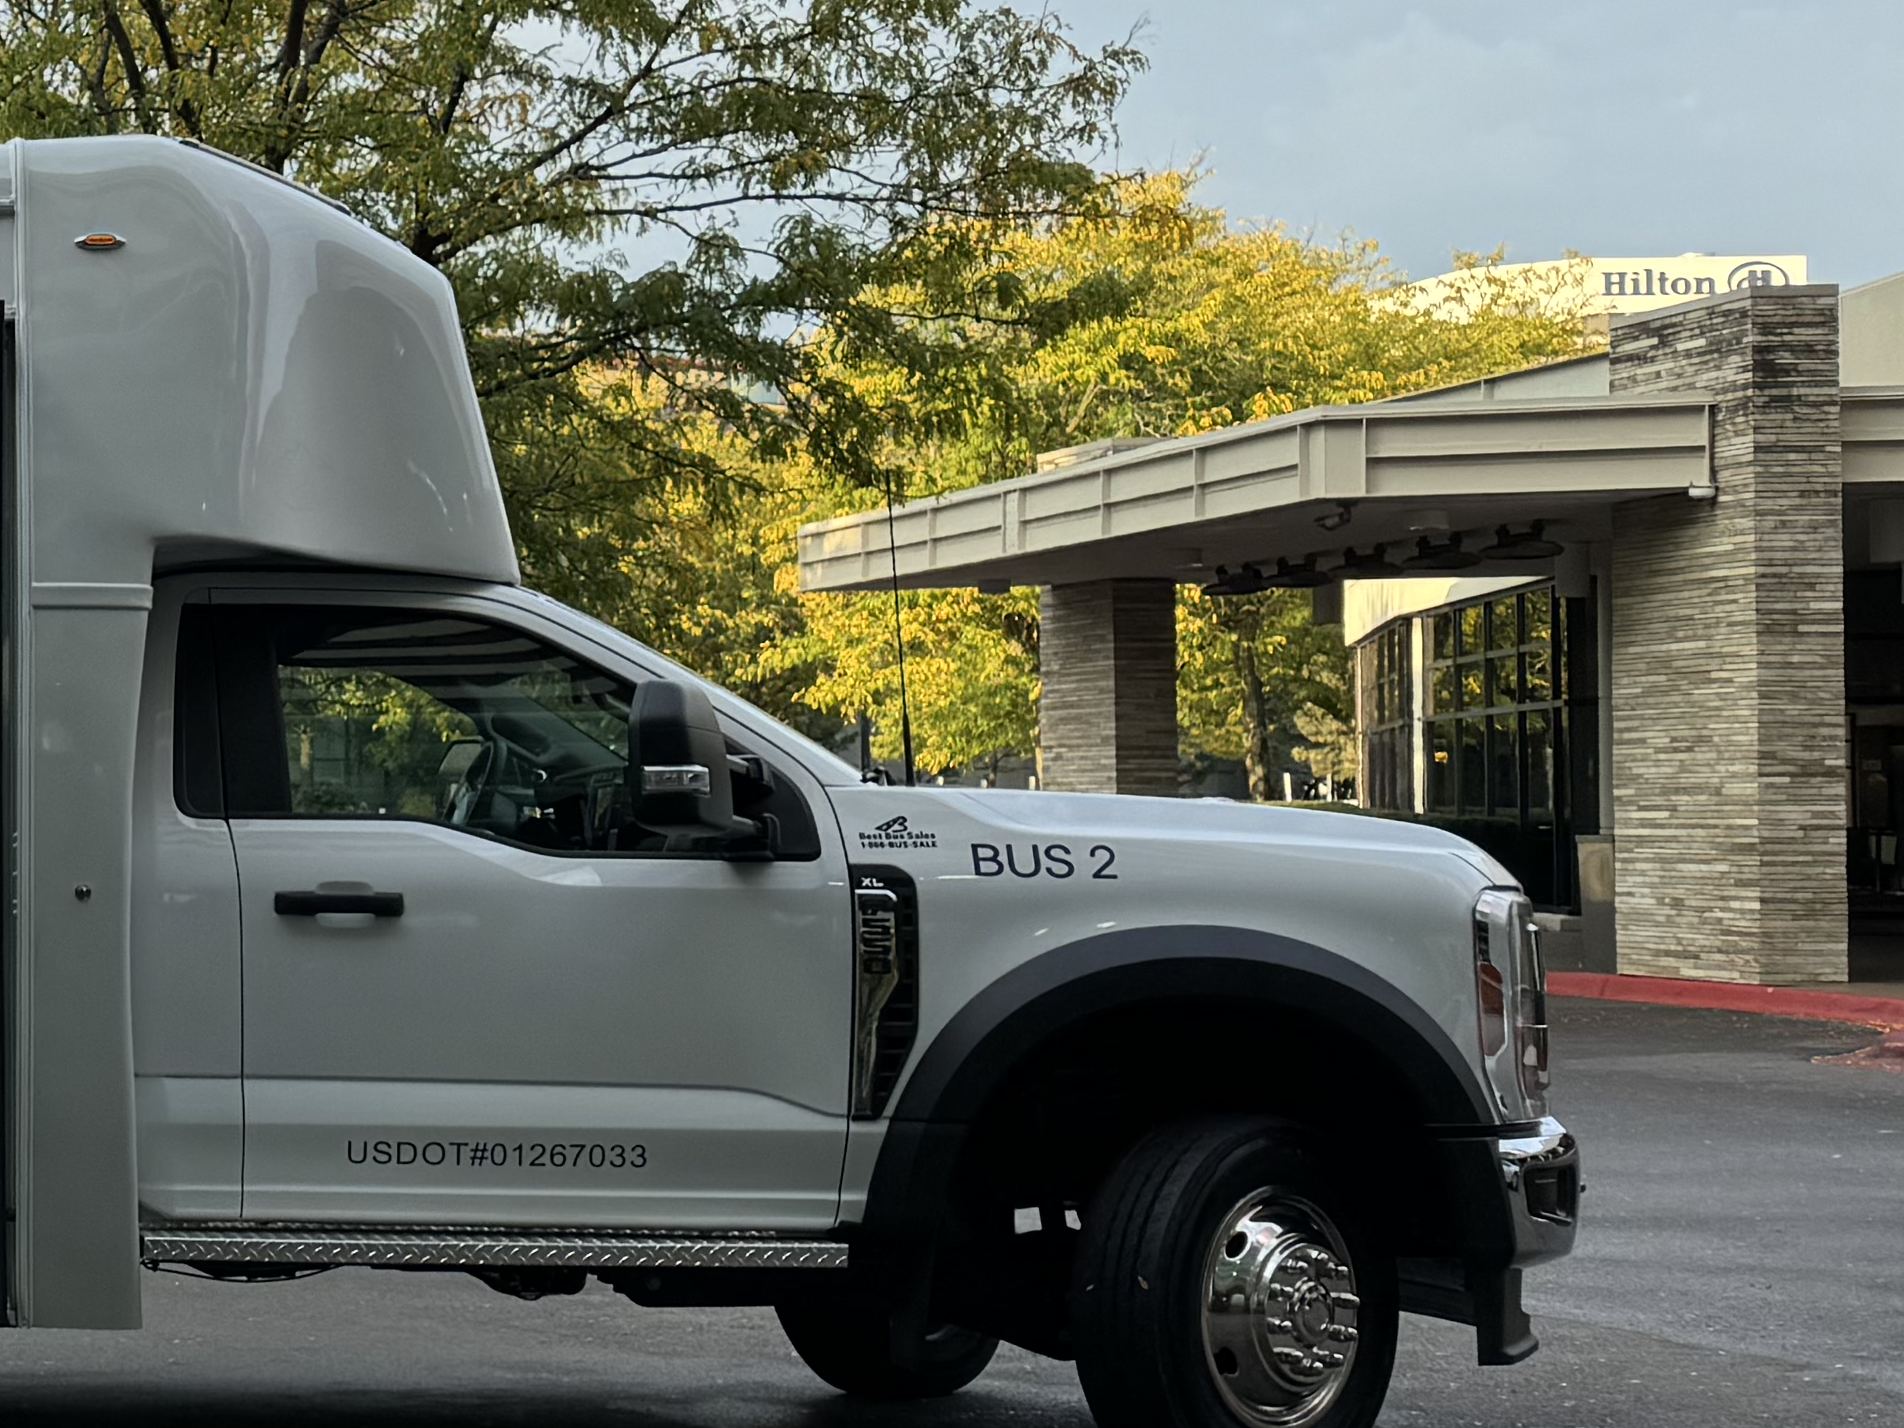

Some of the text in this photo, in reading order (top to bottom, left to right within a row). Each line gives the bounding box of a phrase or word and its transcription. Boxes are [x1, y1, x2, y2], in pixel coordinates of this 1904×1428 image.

[1602, 269, 1716, 296] Hilton
[971, 843, 1118, 880] BUS 2
[861, 877, 884, 887] XL
[346, 1140, 648, 1168] USDOT#01267033
